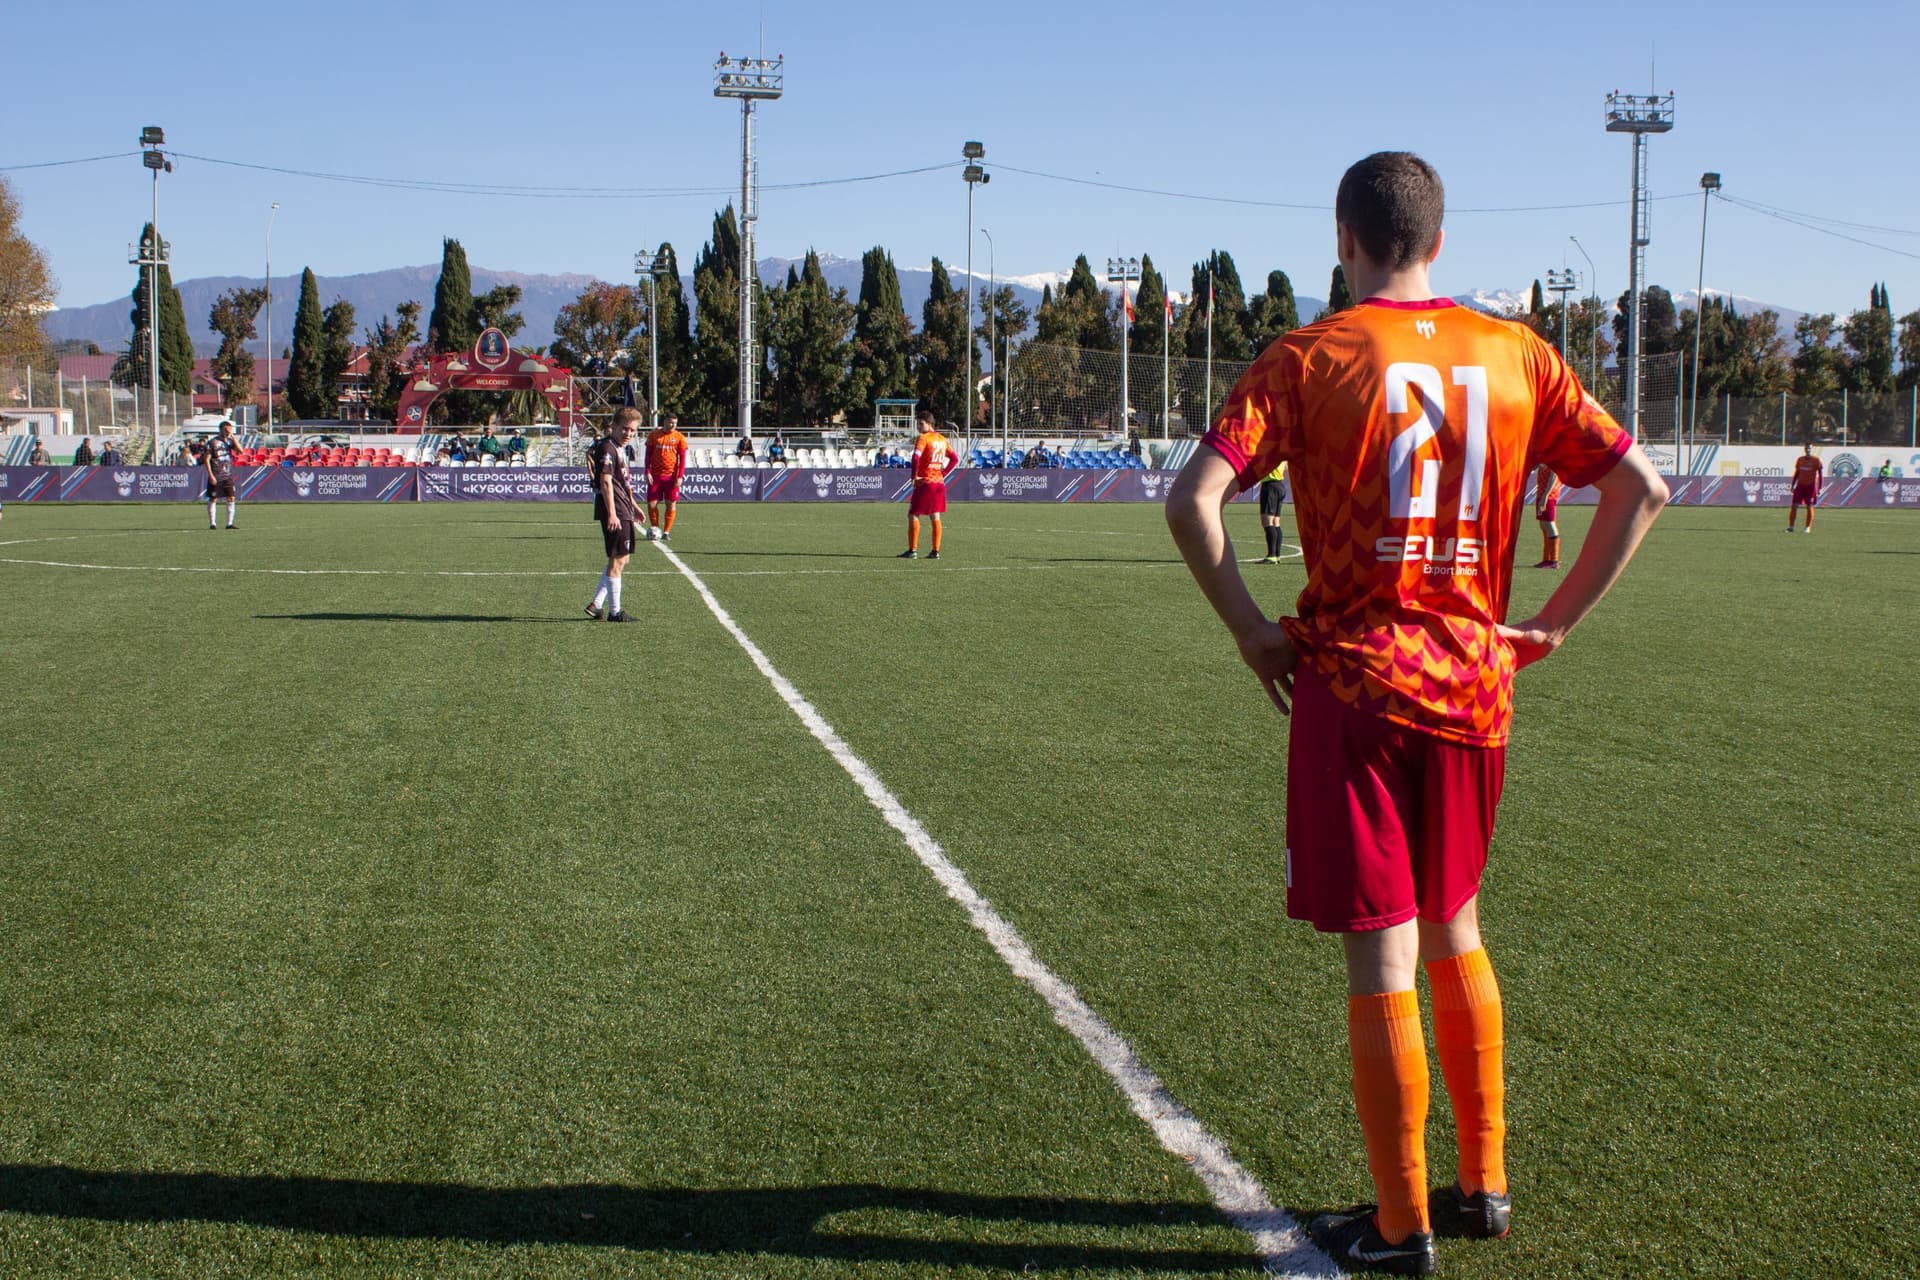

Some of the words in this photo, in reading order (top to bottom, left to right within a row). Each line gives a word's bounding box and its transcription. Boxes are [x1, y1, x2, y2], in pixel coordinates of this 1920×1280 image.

[1385, 361, 1489, 521] 21
[1744, 466, 1784, 476] xiaomi
[139, 473, 189, 481] РОССИЙСКИЙ
[318, 473, 367, 481] РОССИЙСКИЙ
[462, 472, 559, 481] ВСЕРОССИЙСКИЕ
[683, 474, 725, 482] УТБОЛУ
[516, 484, 558, 495] СРЕДИ
[1375, 535, 1483, 563] SEUS
[1423, 564, 1454, 577] Export
